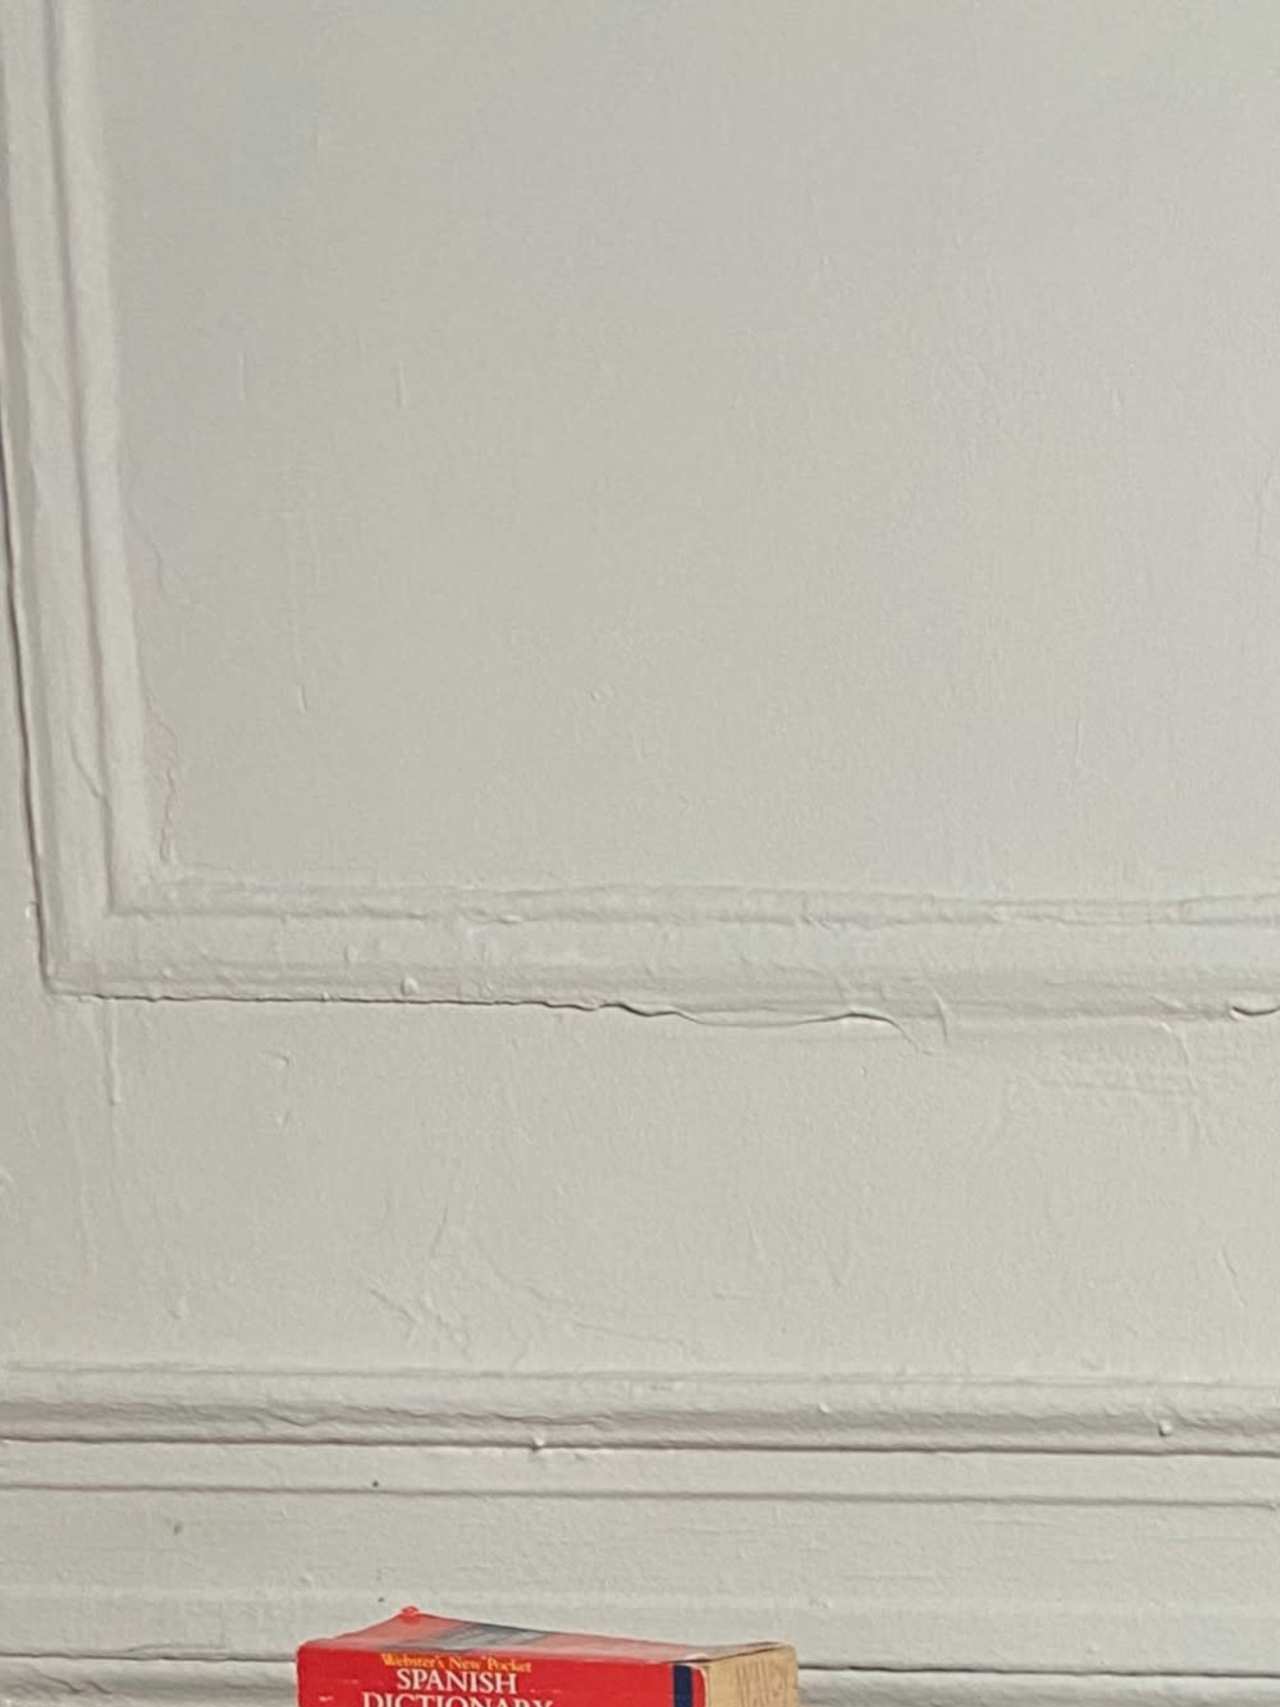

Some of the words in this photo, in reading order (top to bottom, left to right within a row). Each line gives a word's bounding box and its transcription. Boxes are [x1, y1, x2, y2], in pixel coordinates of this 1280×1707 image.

[382, 1653, 441, 1669] Webster's
[487, 1657, 532, 1673] Pocket
[396, 1669, 517, 1695] SPANISH
